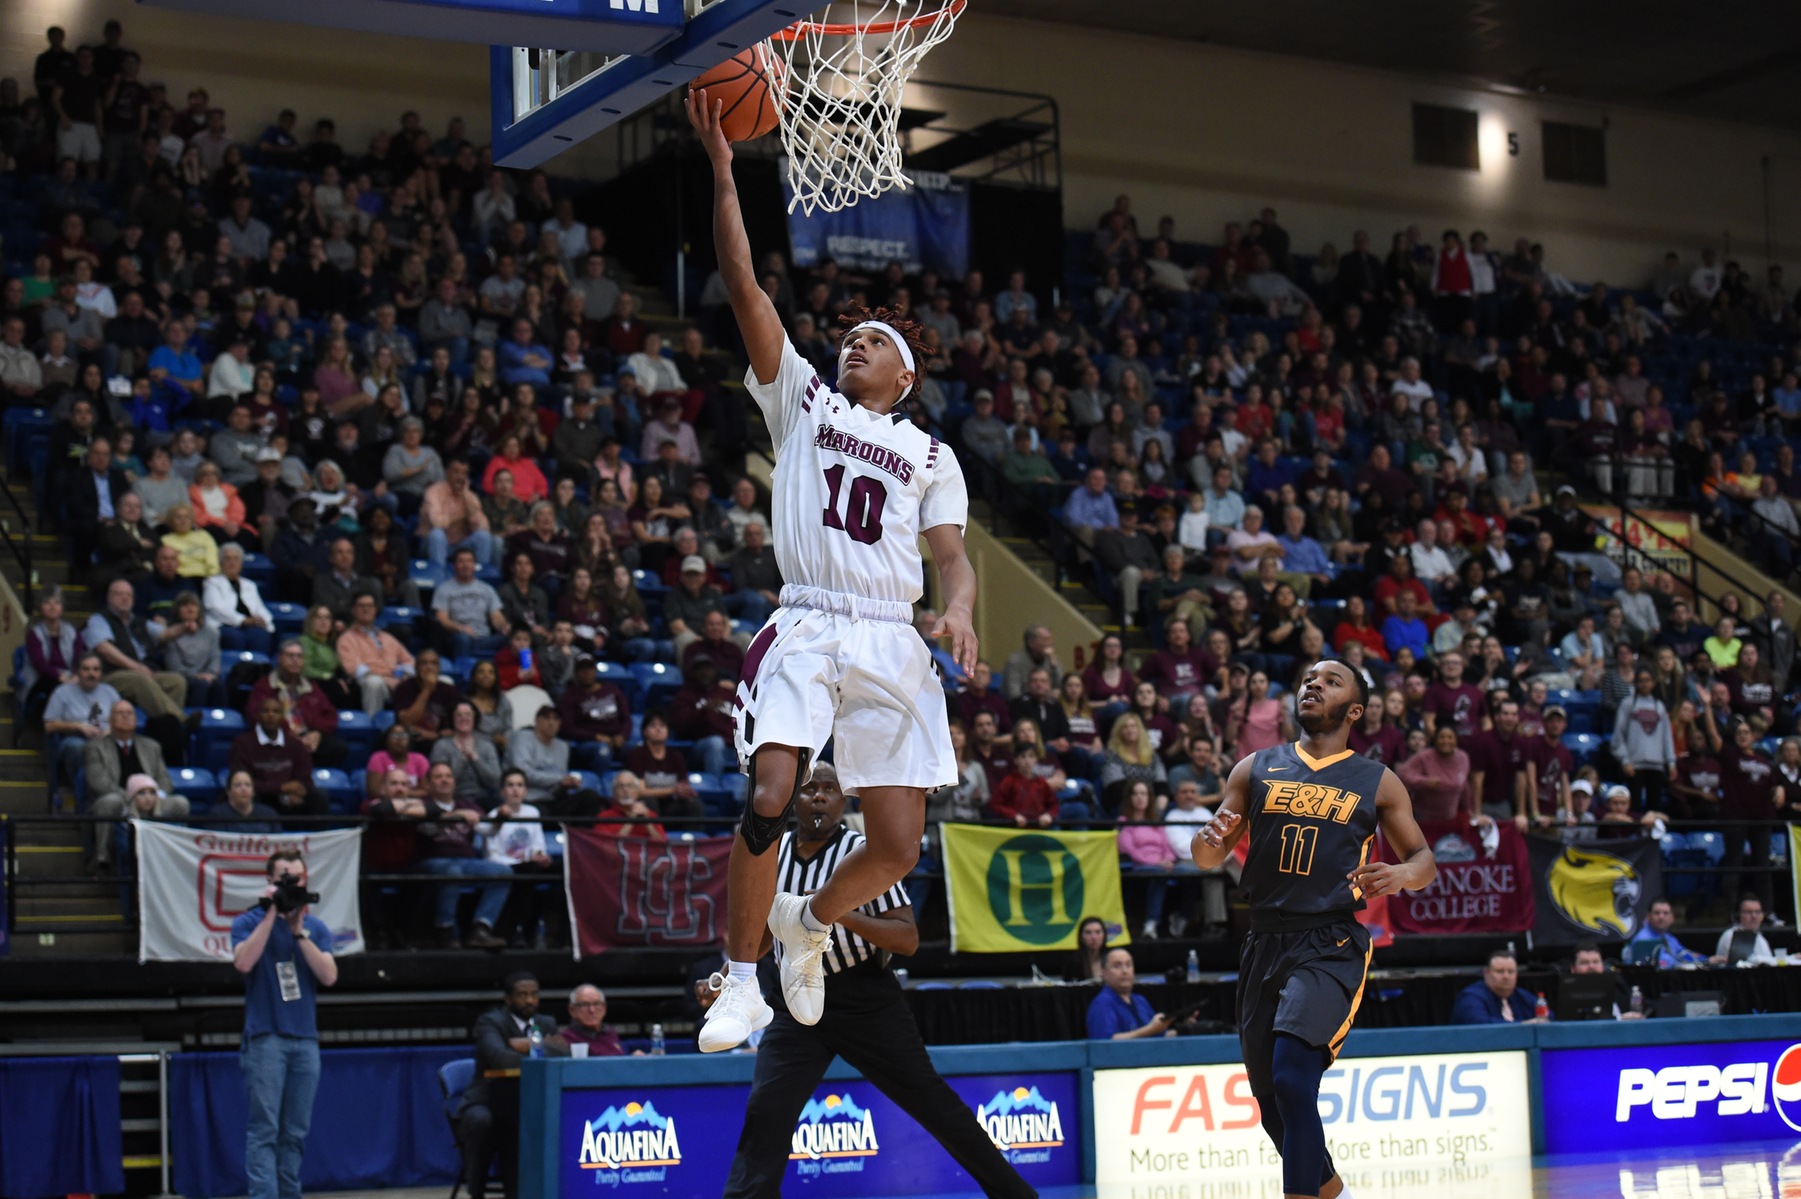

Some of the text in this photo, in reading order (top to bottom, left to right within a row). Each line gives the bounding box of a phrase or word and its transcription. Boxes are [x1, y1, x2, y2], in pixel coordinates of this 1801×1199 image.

[1507, 131, 1520, 156] 5
[814, 424, 915, 486] MAROONS
[823, 464, 887, 545] 10
[1262, 780, 1361, 825] E&H
[1279, 824, 1319, 876] 11
[1395, 864, 1516, 898] ANOKE
[1410, 894, 1501, 921] COLLEGE
[1129, 1062, 1489, 1136] FASSIGNS
[1616, 1062, 1769, 1122] PEPSI
[578, 1116, 682, 1169] AQUAFINA
[1130, 1148, 1189, 1173] More
[1198, 1142, 1250, 1169] than
[1380, 1133, 1428, 1158] than
